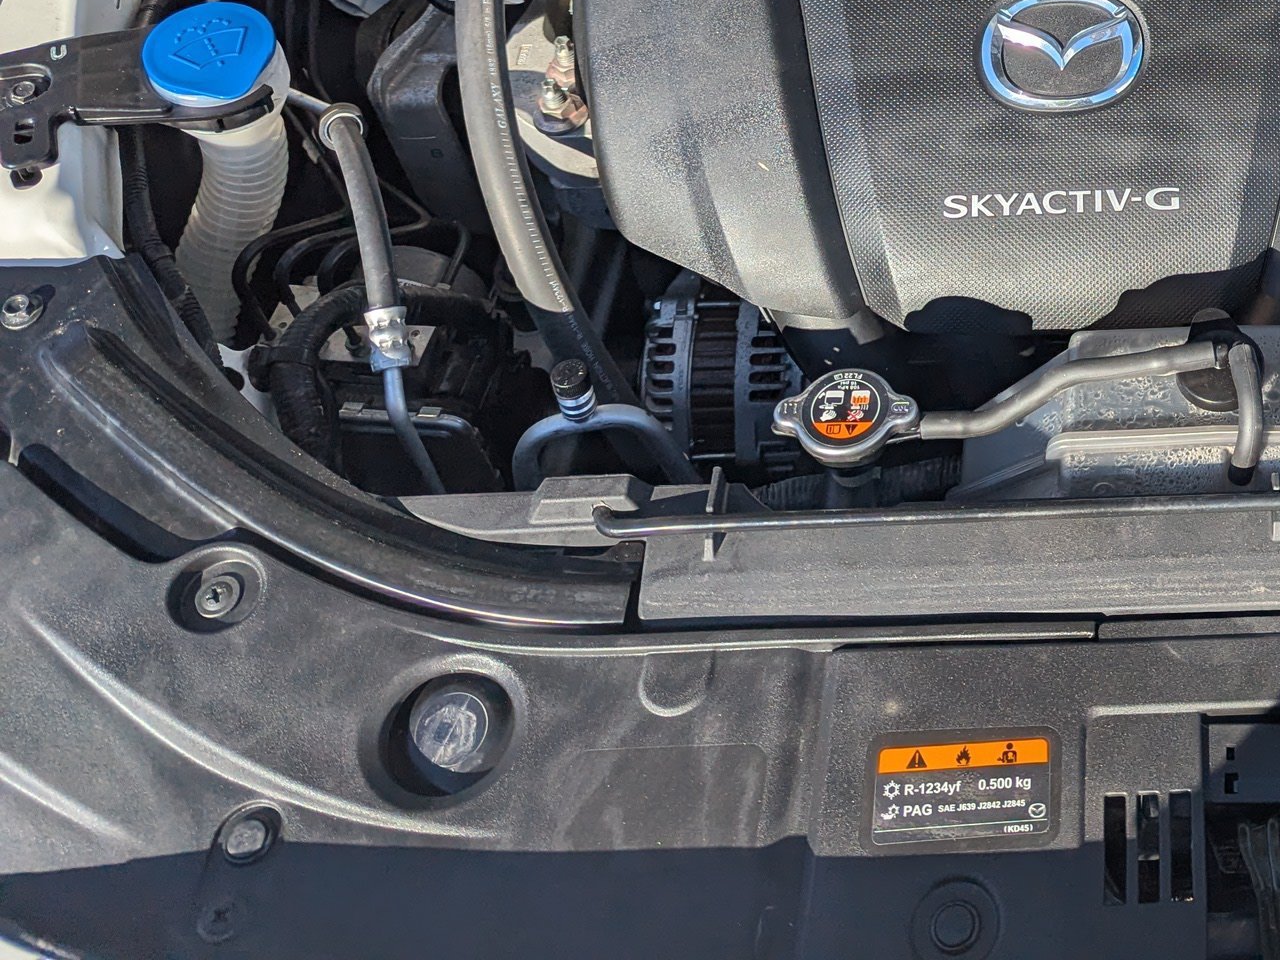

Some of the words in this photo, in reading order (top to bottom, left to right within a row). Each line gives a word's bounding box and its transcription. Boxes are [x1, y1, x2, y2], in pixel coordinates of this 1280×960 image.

[490, 82, 508, 129] GALAXY
[943, 187, 1180, 218] SKYACTIV-G
[904, 780, 961, 796] R-1234yf
[978, 777, 1013, 791] 0.500
[1015, 776, 1032, 790] kg
[903, 805, 933, 818] PAG
[938, 804, 956, 813] SAE
[957, 803, 976, 811] J639
[977, 801, 1001, 810] J2842
[1002, 799, 1026, 809] J2845
[1003, 824, 1034, 833] (KD45)
